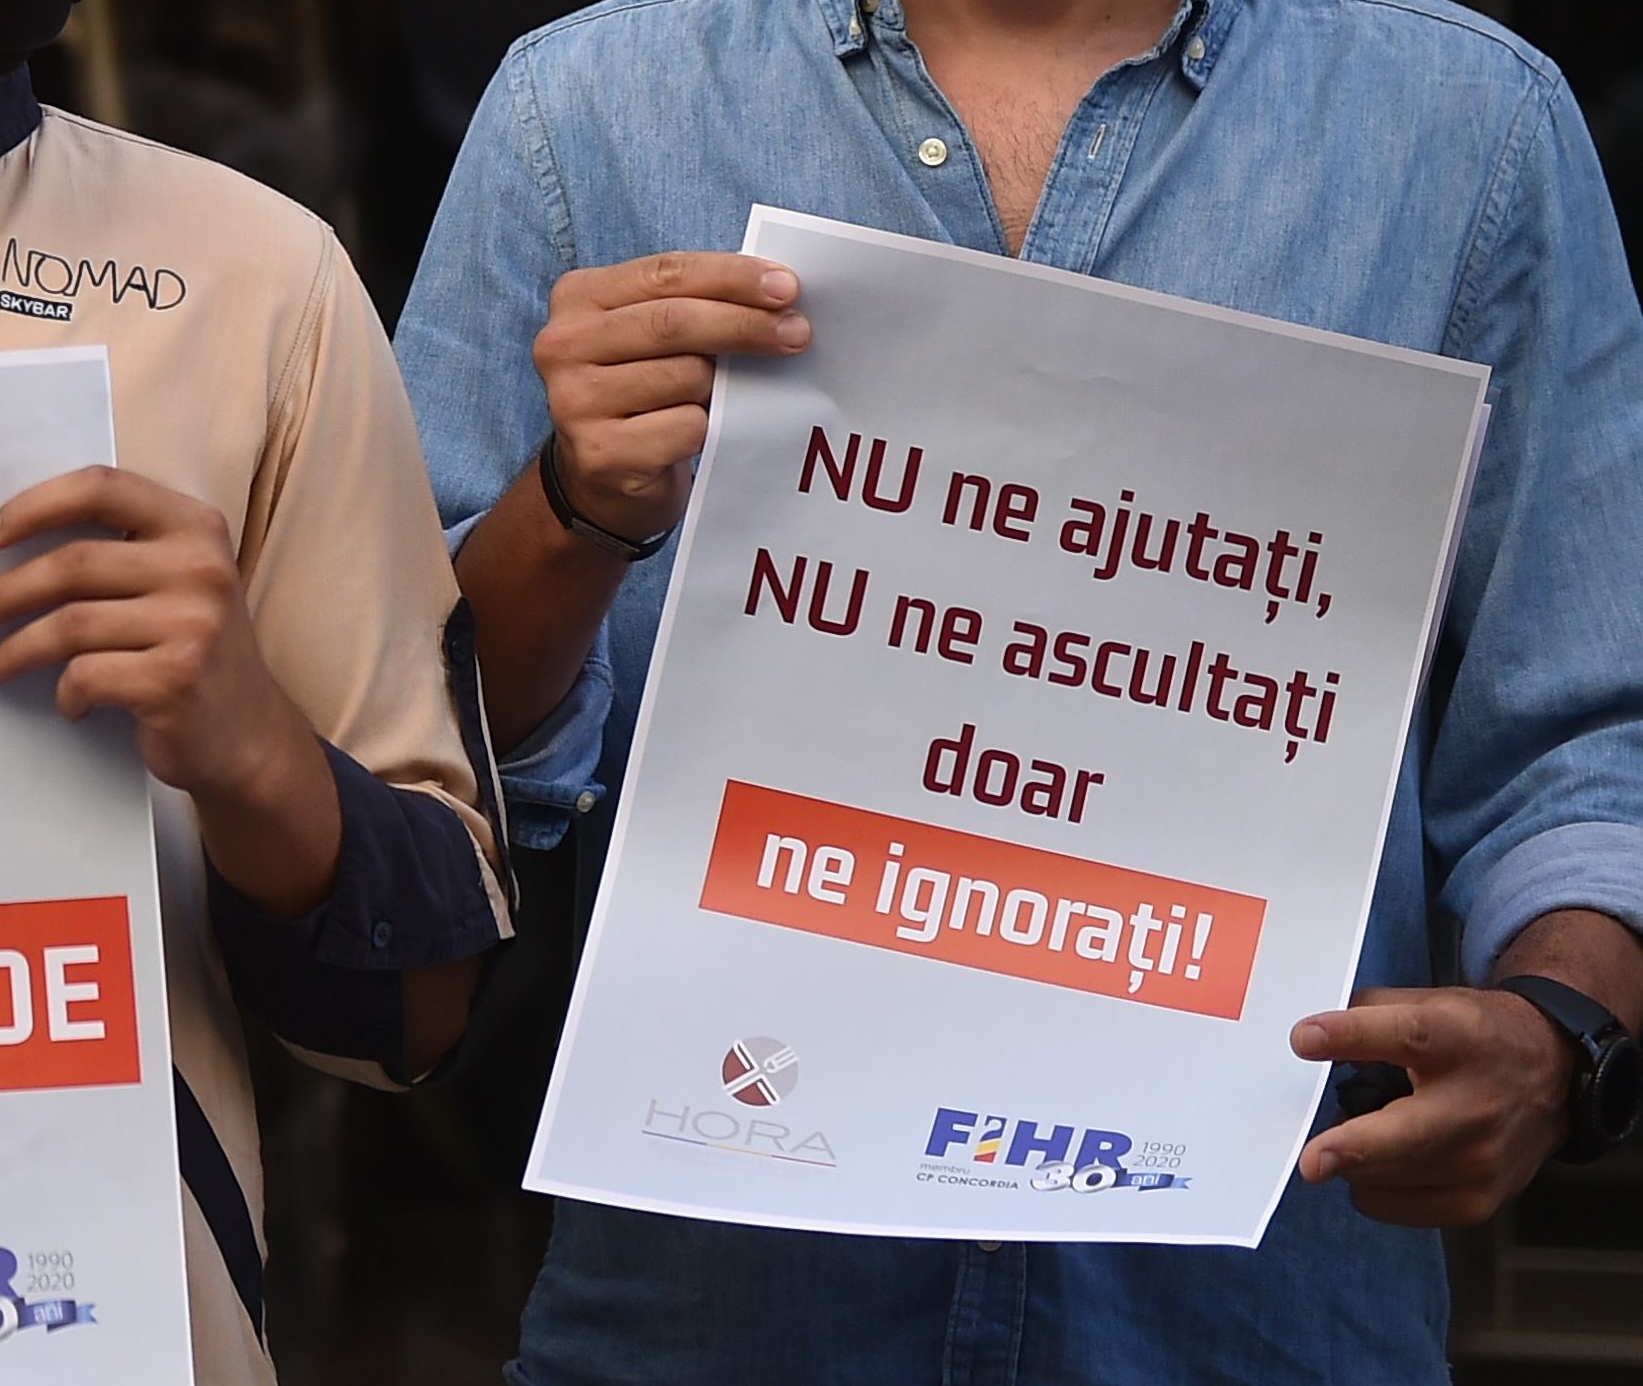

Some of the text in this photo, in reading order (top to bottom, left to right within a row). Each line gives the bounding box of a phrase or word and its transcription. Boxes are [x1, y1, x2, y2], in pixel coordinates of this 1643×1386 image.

[2, 238, 186, 310] NOMAD
[797, 425, 1333, 624] NU ne ajutați,
[743, 547, 1341, 764] NU ne ascultați
[922, 723, 1105, 824] doar
[756, 832, 1213, 994] ne ignorați!
[645, 1098, 836, 1160] HORA
[1142, 1141, 1186, 1157] 1990
[919, 1162, 971, 1176] membru
[1132, 1155, 1181, 1170] 2020
[938, 1174, 1019, 1190] CONCORDIA
[1130, 1172, 1161, 1187] ani
[27, 1252, 74, 1271] 1990
[26, 1272, 75, 1291] 2020
